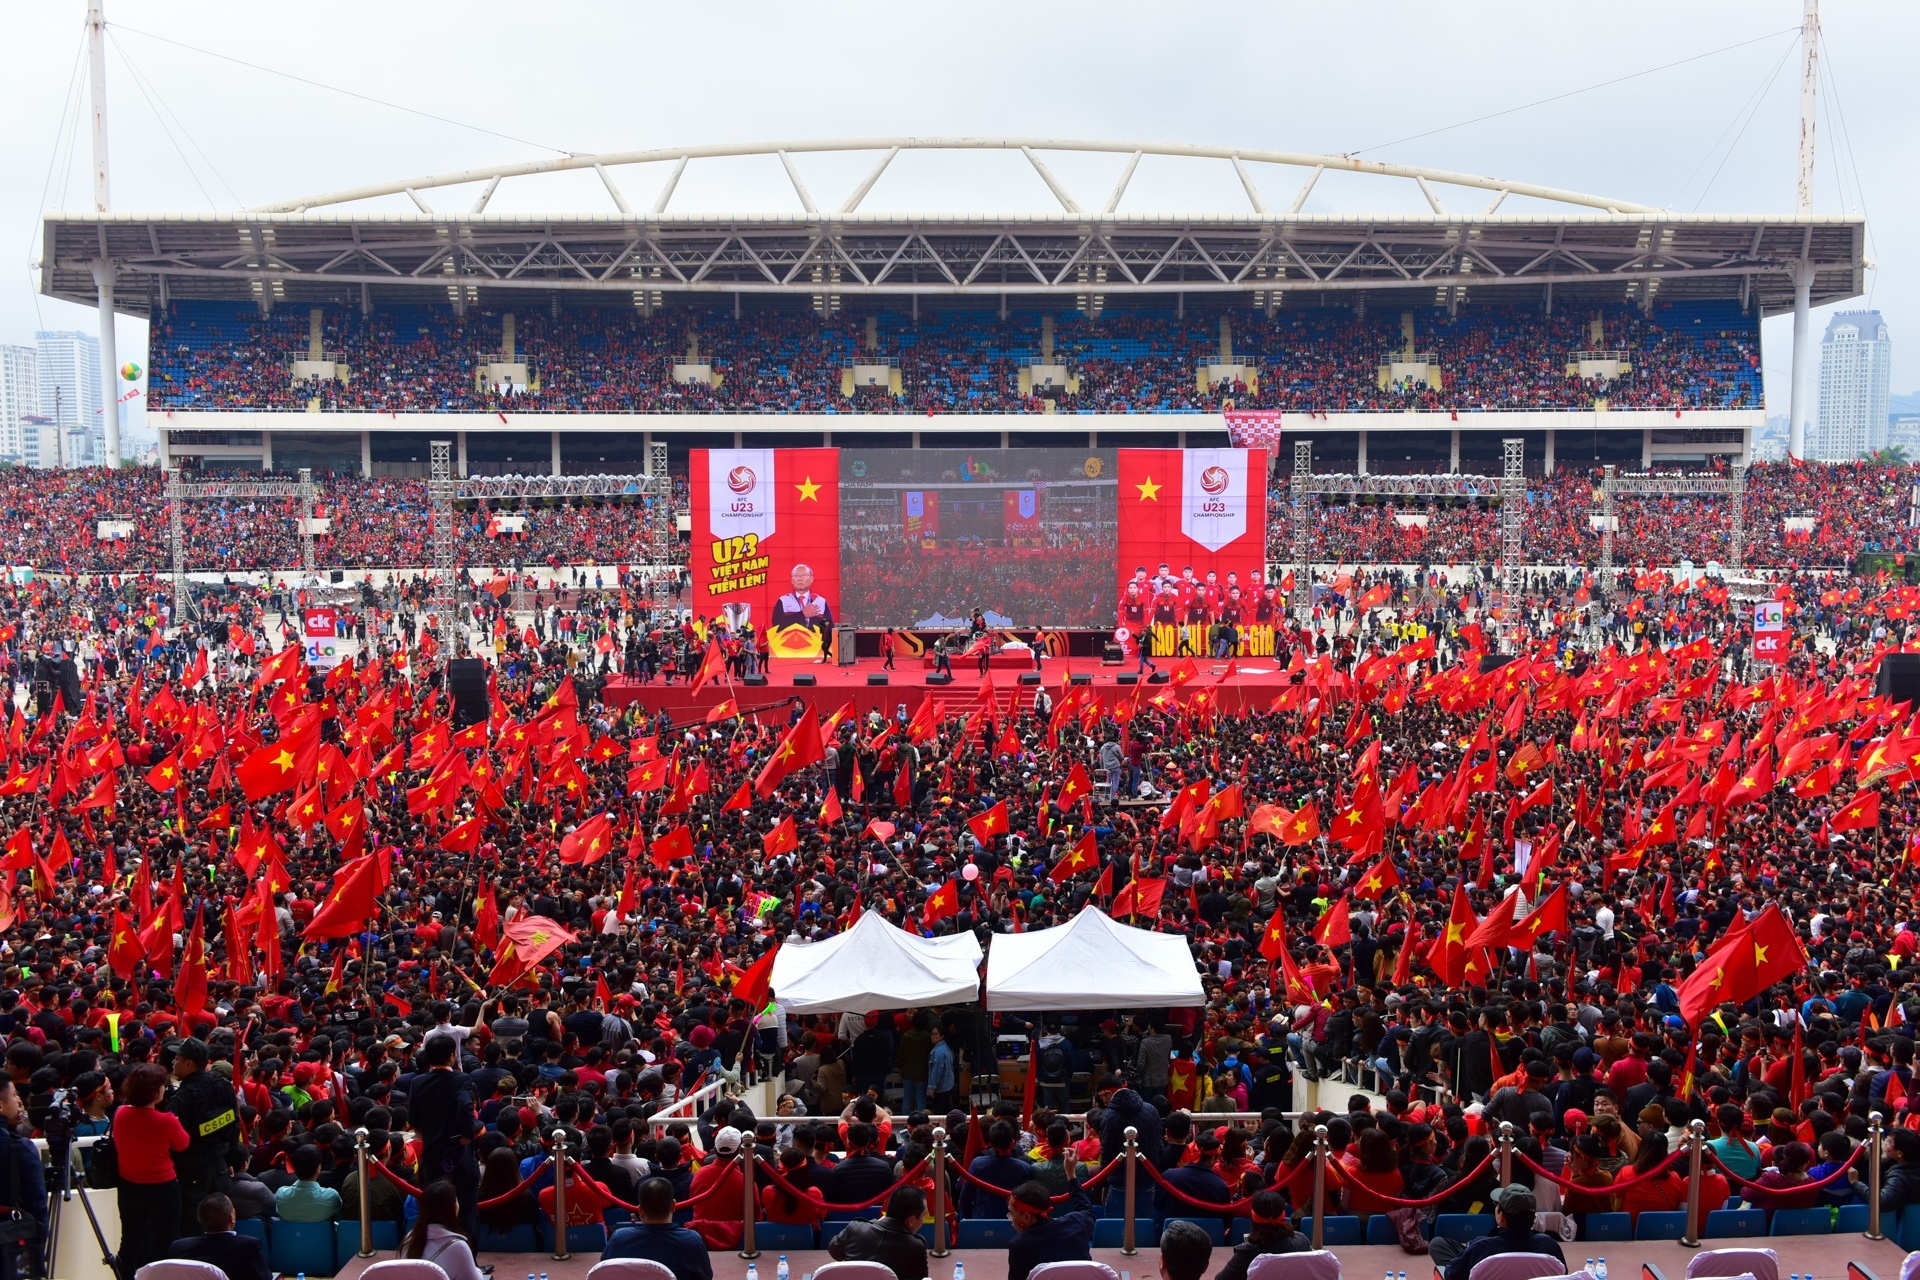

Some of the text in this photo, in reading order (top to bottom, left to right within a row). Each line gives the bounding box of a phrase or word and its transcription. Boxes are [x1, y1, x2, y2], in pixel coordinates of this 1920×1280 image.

[731, 503, 753, 512] U23
[1203, 503, 1225, 512] U23
[712, 534, 758, 563] U23
[742, 556, 769, 572] NAM
[739, 573, 766, 589] LÊN!
[308, 614, 330, 628] ck
[1250, 624, 1274, 656] GIA
[1756, 636, 1778, 650] ck
